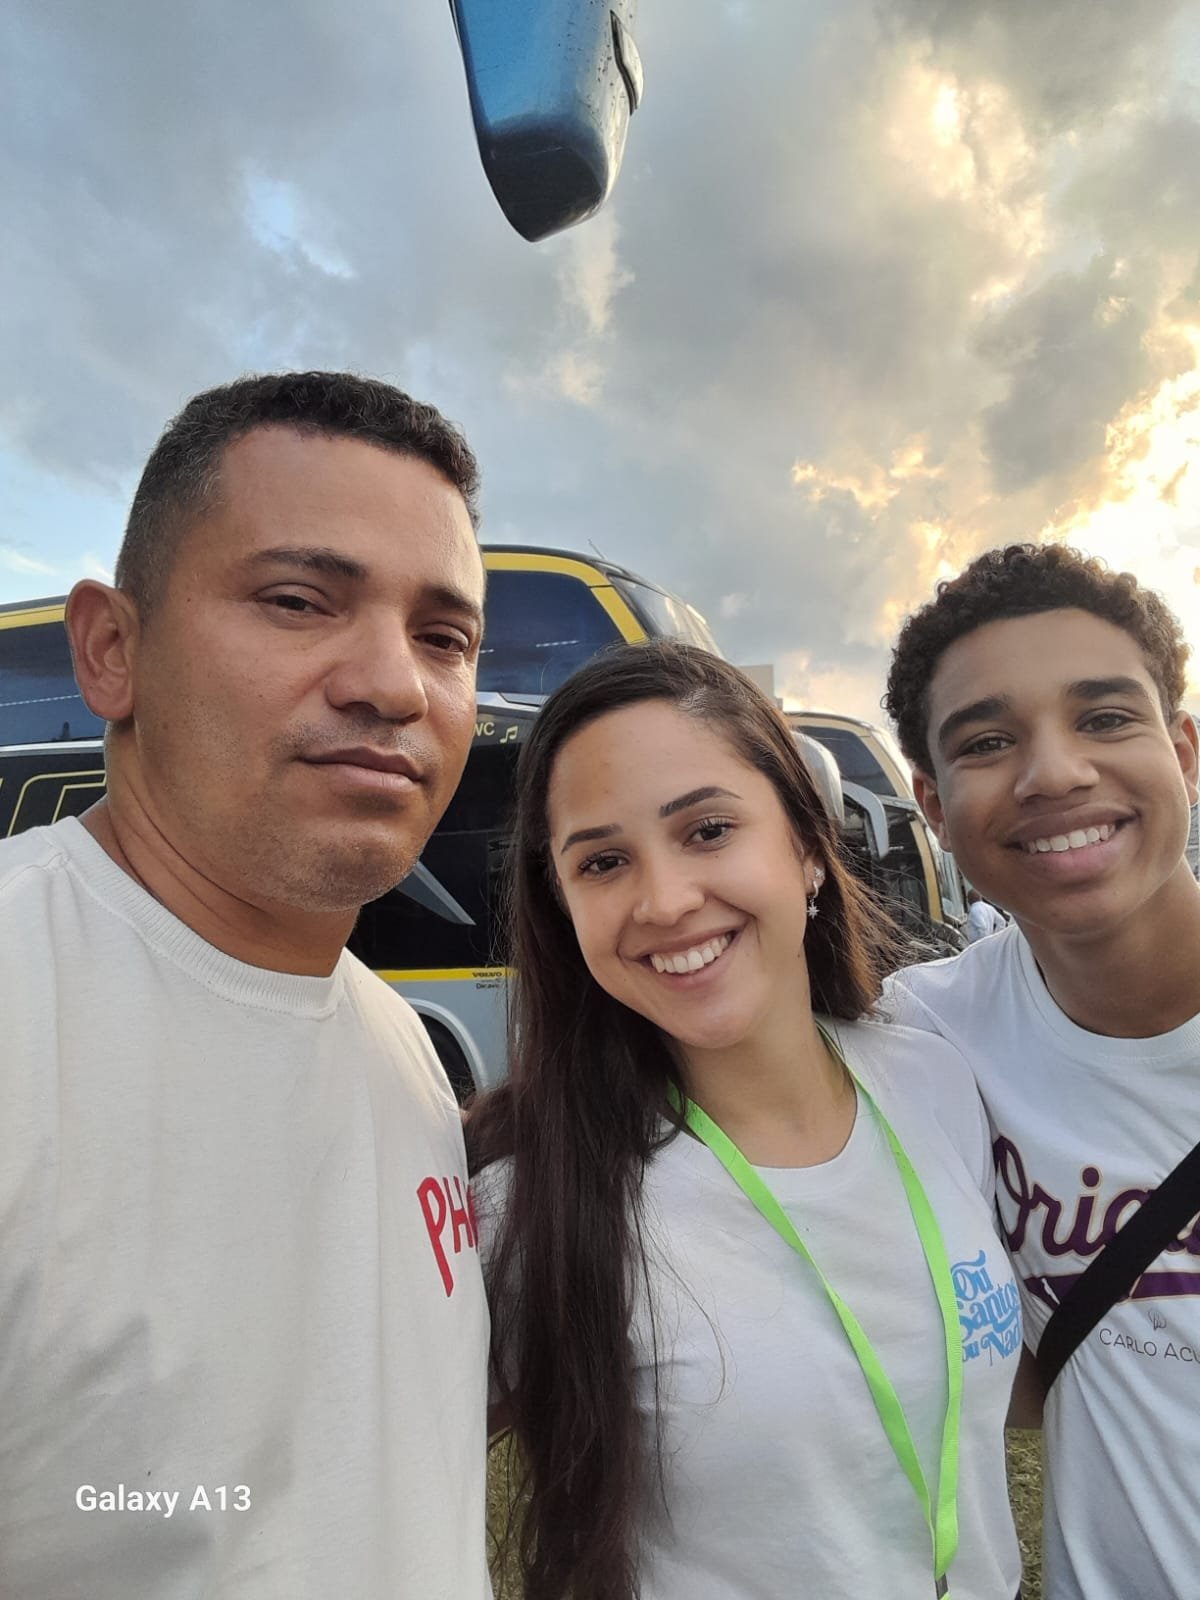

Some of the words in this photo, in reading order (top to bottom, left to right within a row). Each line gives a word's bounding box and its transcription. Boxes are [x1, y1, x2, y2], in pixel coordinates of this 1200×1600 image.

[951, 1249, 994, 1301] Ou
[980, 1312, 1021, 1367] Nad
[1099, 1327, 1158, 1357] CARLO
